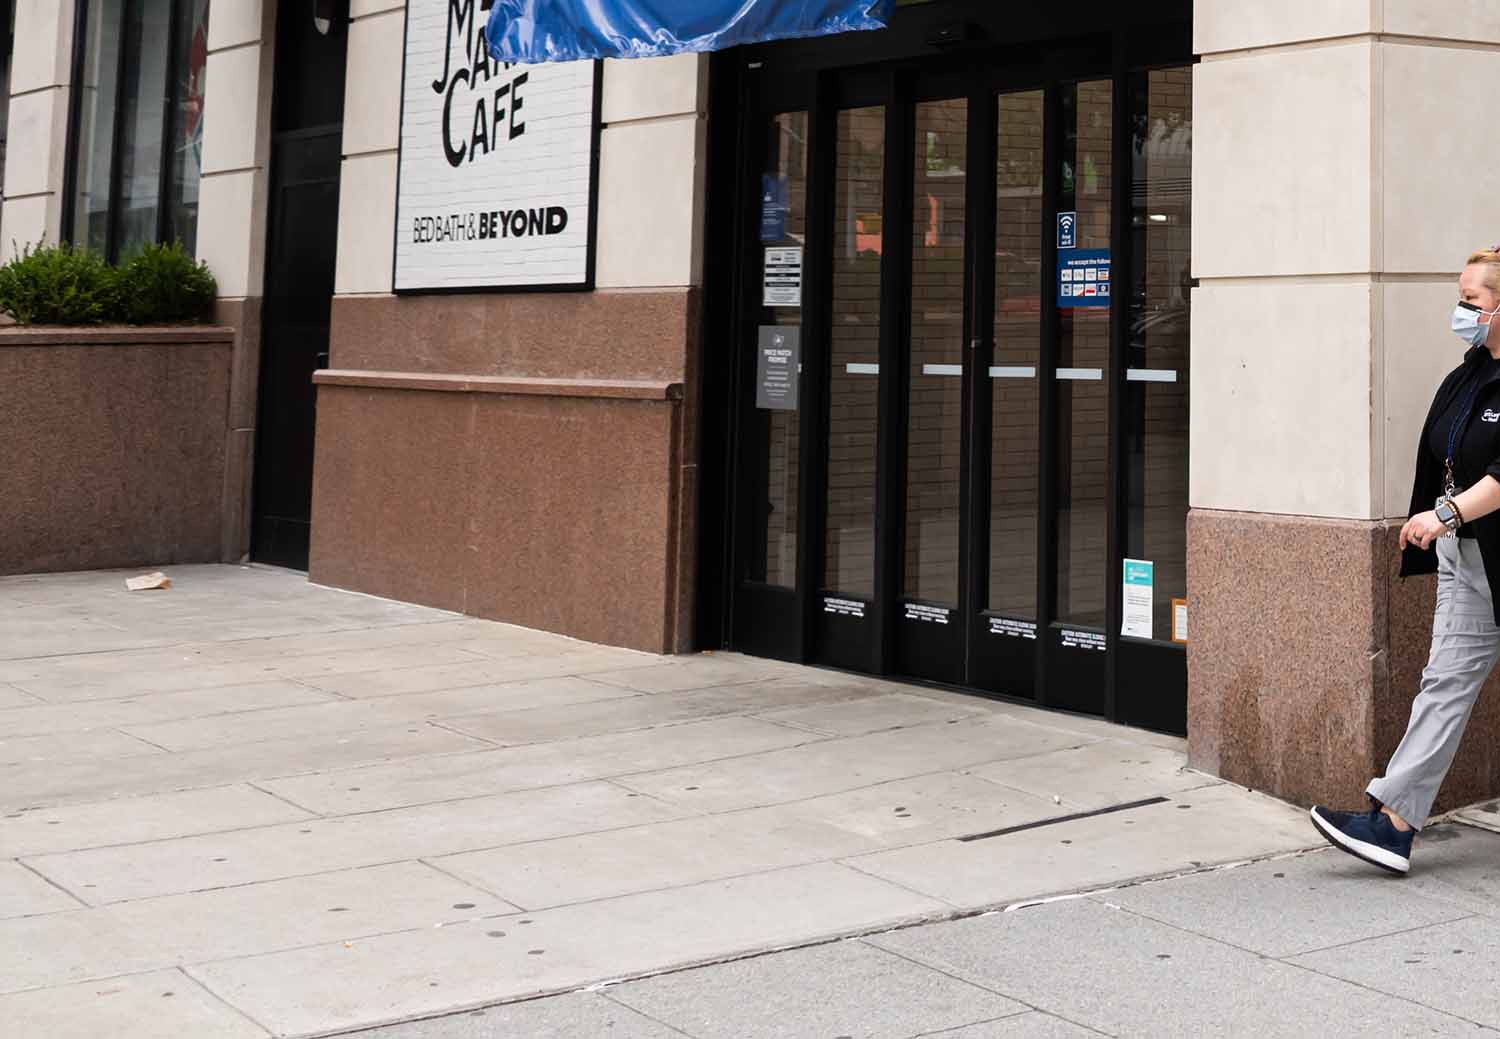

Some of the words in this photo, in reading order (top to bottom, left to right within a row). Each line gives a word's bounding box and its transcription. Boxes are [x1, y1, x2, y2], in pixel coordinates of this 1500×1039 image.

[442, 68, 528, 168] CAFE
[413, 216, 434, 243] BED
[436, 214, 466, 241] BATH
[467, 212, 477, 240] &
[479, 206, 568, 239] BEYOND
